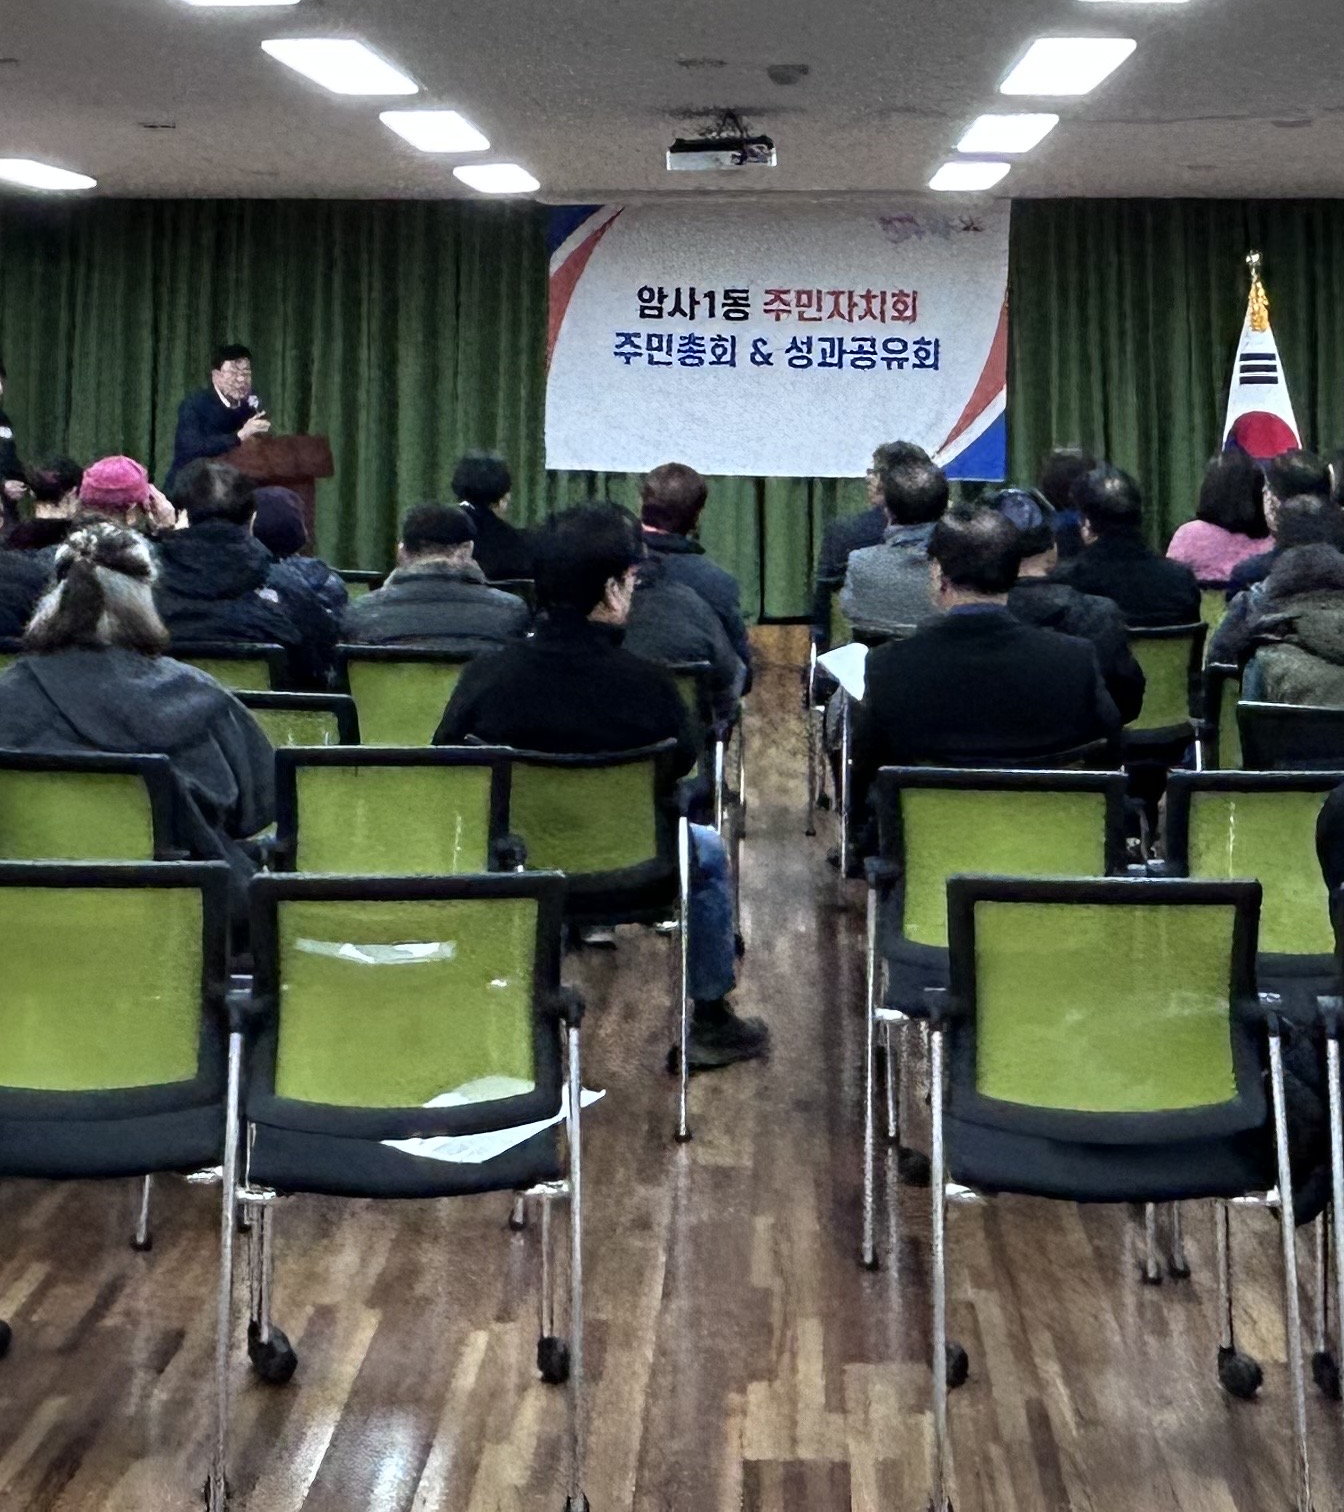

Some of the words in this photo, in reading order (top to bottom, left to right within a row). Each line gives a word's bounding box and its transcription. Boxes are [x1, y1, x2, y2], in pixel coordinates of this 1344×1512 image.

[637, 285, 750, 321] 암사1동
[763, 288, 918, 324] 주민자치회
[613, 332, 736, 368] 주민총회
[750, 337, 774, 368] &
[785, 335, 940, 371] 성과공유회
